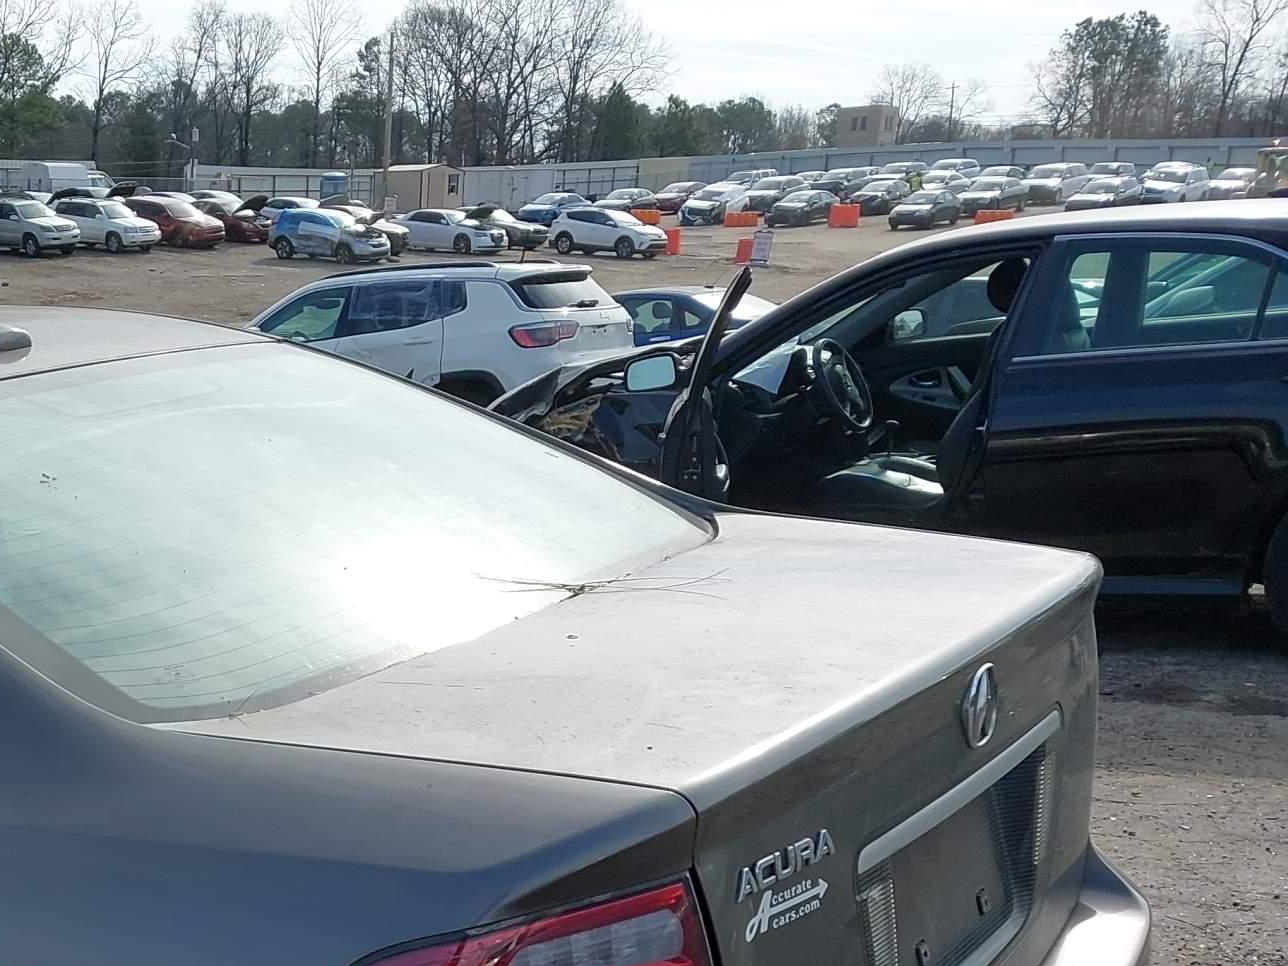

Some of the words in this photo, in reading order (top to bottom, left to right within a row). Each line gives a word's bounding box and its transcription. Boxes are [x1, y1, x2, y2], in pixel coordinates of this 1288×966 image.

[735, 828, 837, 904] ACURA
[745, 877, 817, 943] Accurate
[772, 898, 822, 930] cars.com
